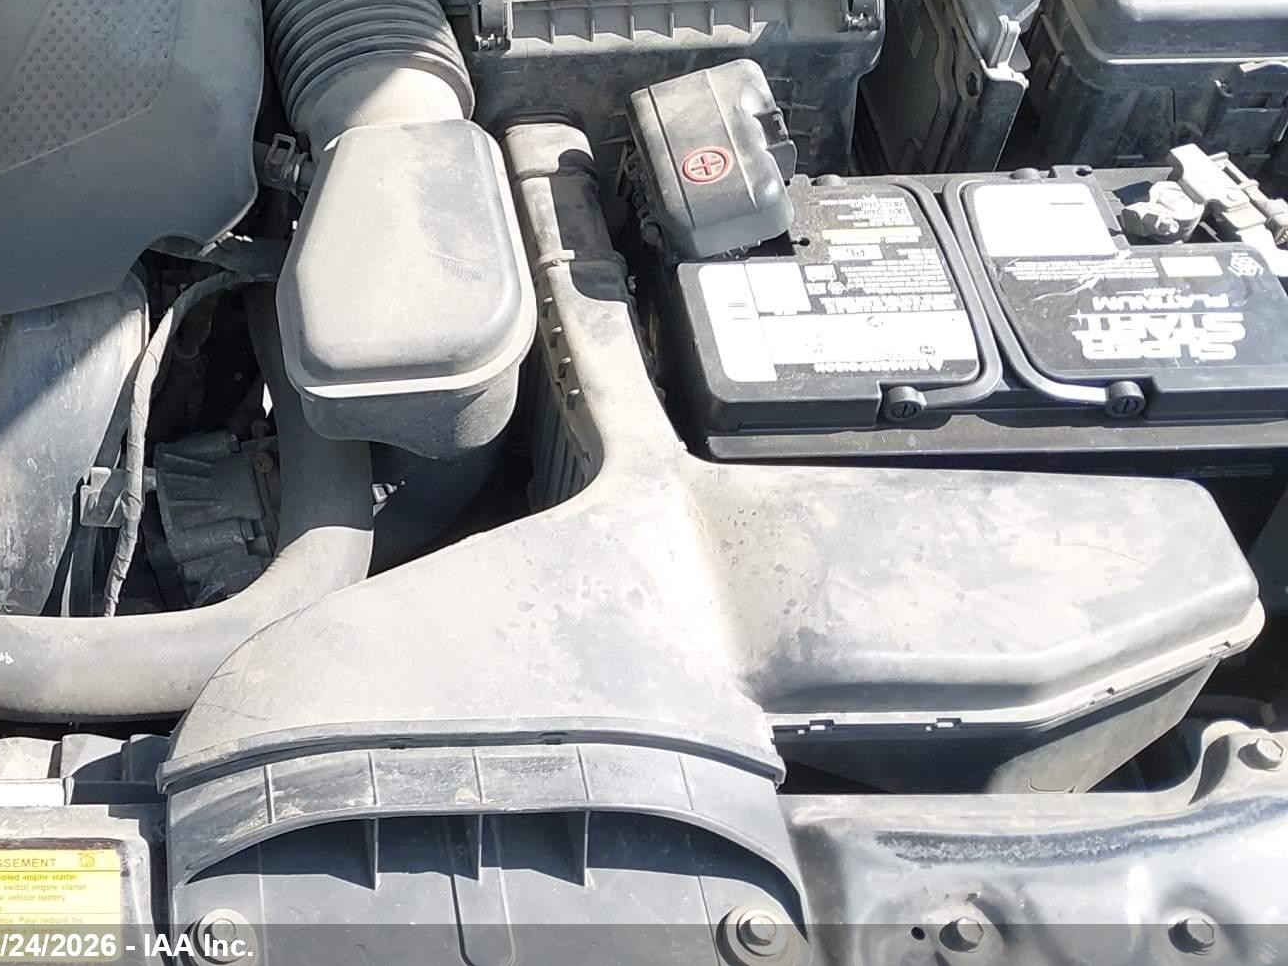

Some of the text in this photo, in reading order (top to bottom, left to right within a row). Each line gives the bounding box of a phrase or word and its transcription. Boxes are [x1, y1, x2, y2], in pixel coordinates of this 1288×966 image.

[1092, 293, 1229, 311] PLATINUM
[1072, 313, 1246, 342] START
[1081, 339, 1237, 361] SUPER
[23, 874, 48, 883] engine
